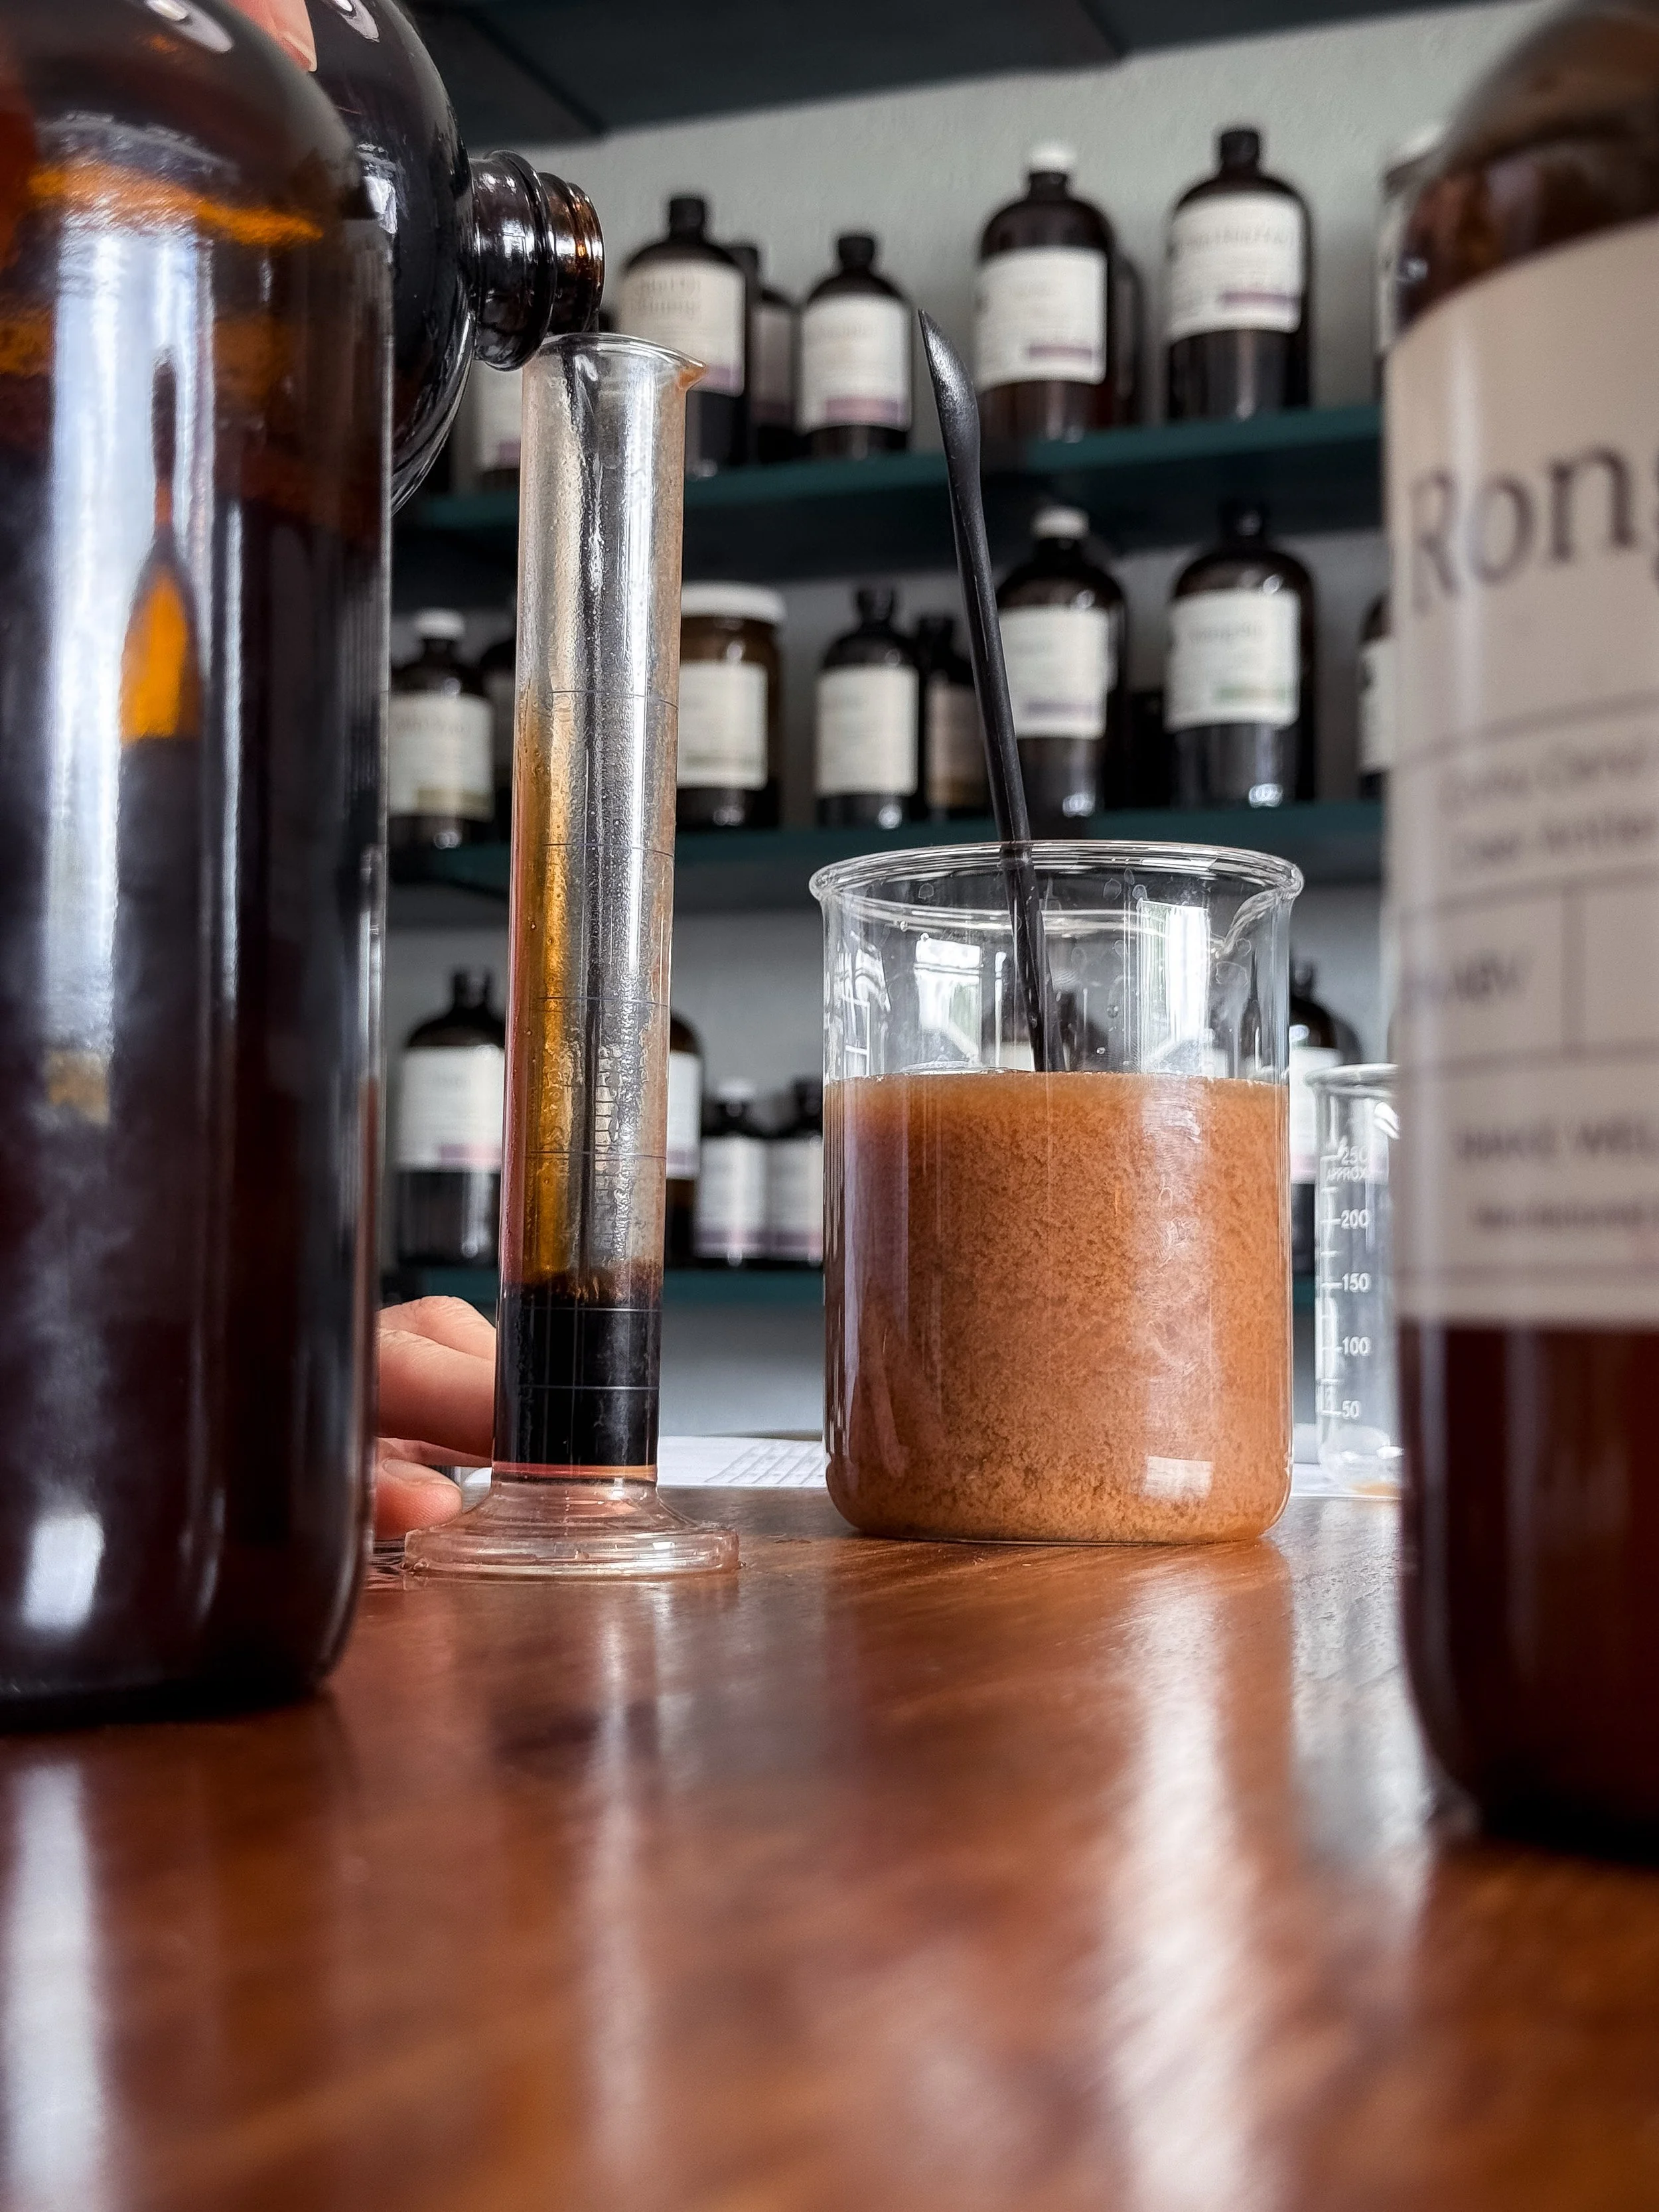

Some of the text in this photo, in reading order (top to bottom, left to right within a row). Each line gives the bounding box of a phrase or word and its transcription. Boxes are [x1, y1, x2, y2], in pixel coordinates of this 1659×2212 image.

[1408, 443, 1659, 616] Ron
[1341, 1145, 1369, 1164] 250
[1341, 1209, 1370, 1229] 200
[1341, 1272, 1371, 1293] 150
[1342, 1336, 1371, 1357] 100
[1341, 1400, 1362, 1420] 50
